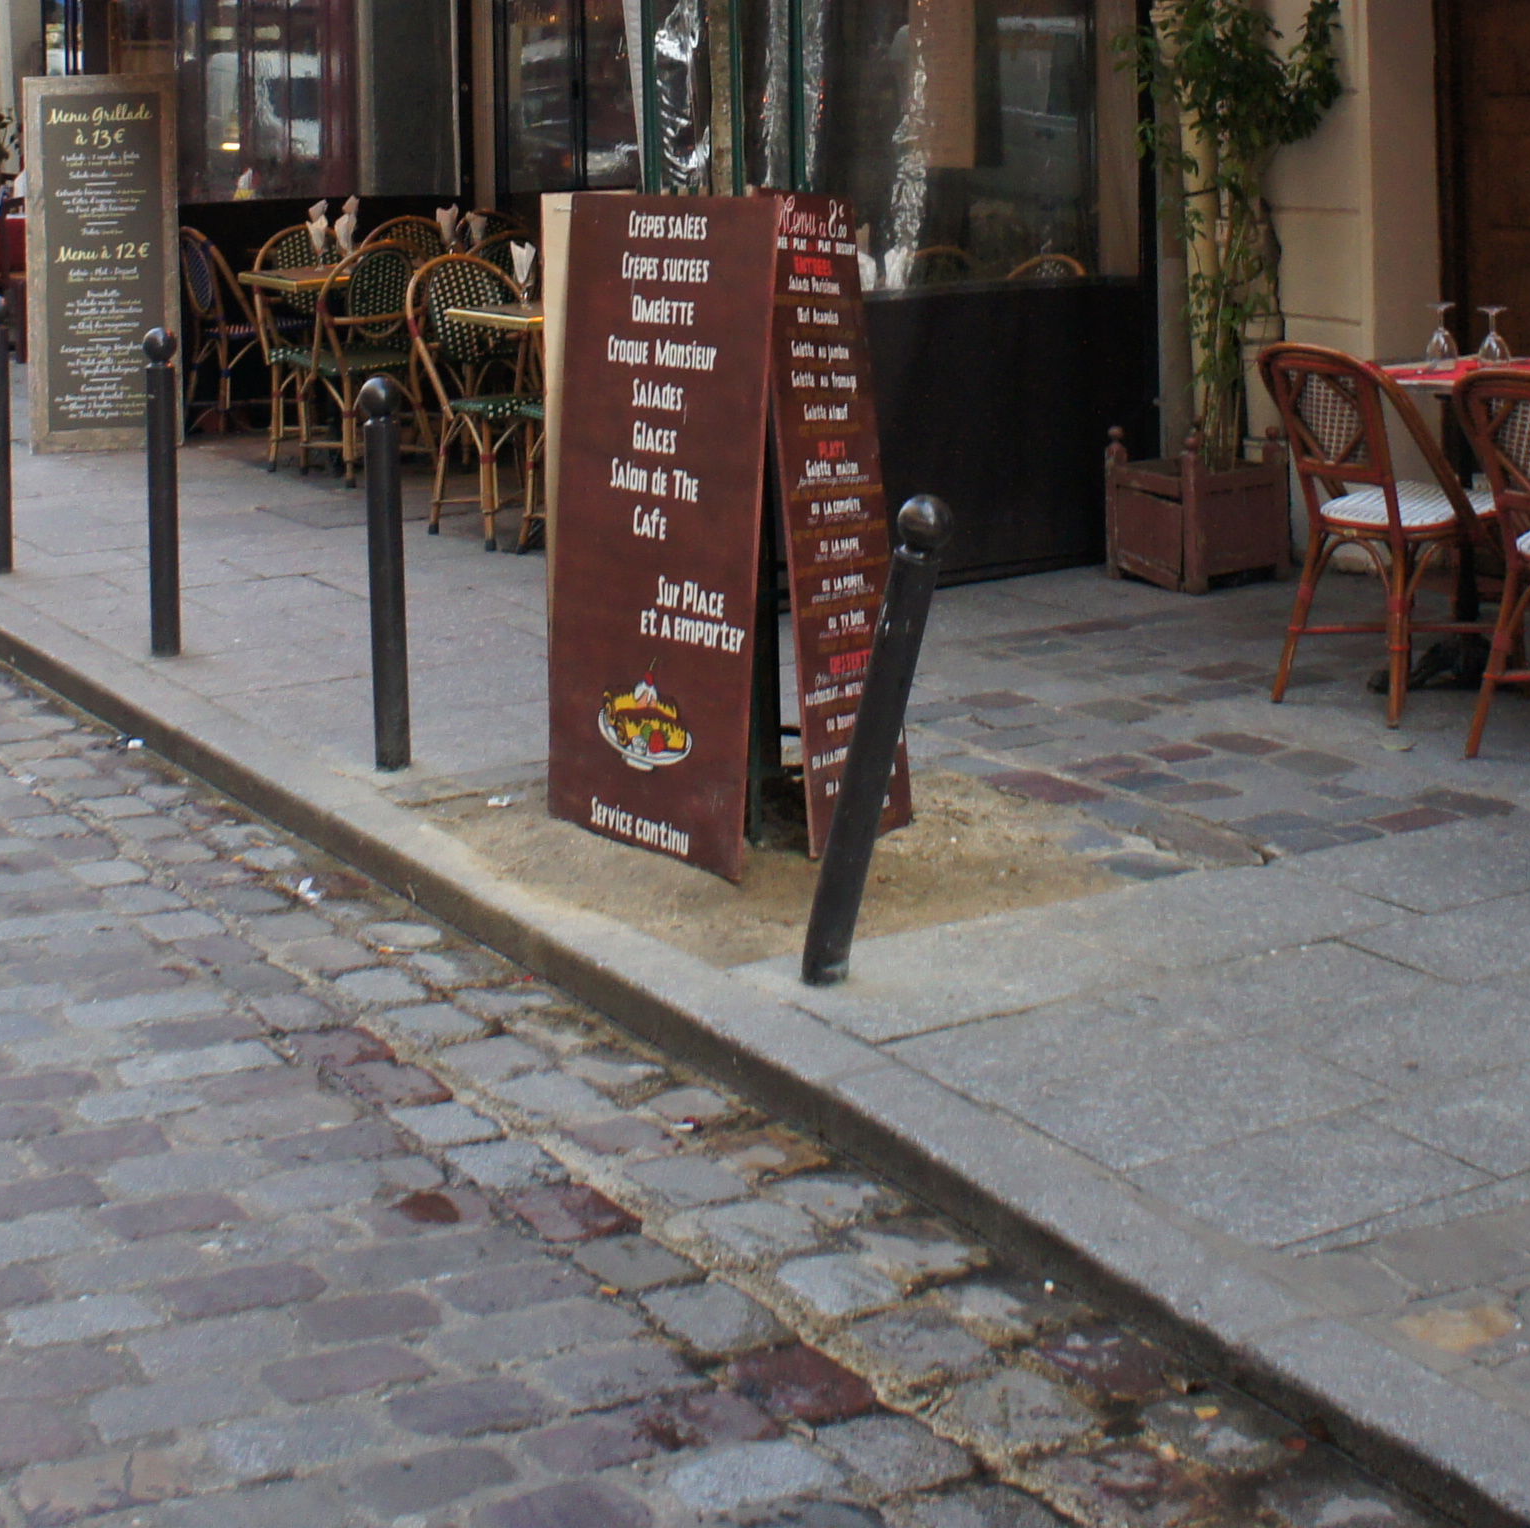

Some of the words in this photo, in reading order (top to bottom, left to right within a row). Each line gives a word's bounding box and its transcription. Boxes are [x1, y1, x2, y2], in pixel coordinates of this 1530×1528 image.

[46, 108, 90, 125] Menu
[92, 104, 153, 126] Grillade
[75, 128, 88, 145] à
[54, 245, 98, 264] Menu
[101, 245, 112, 260] à
